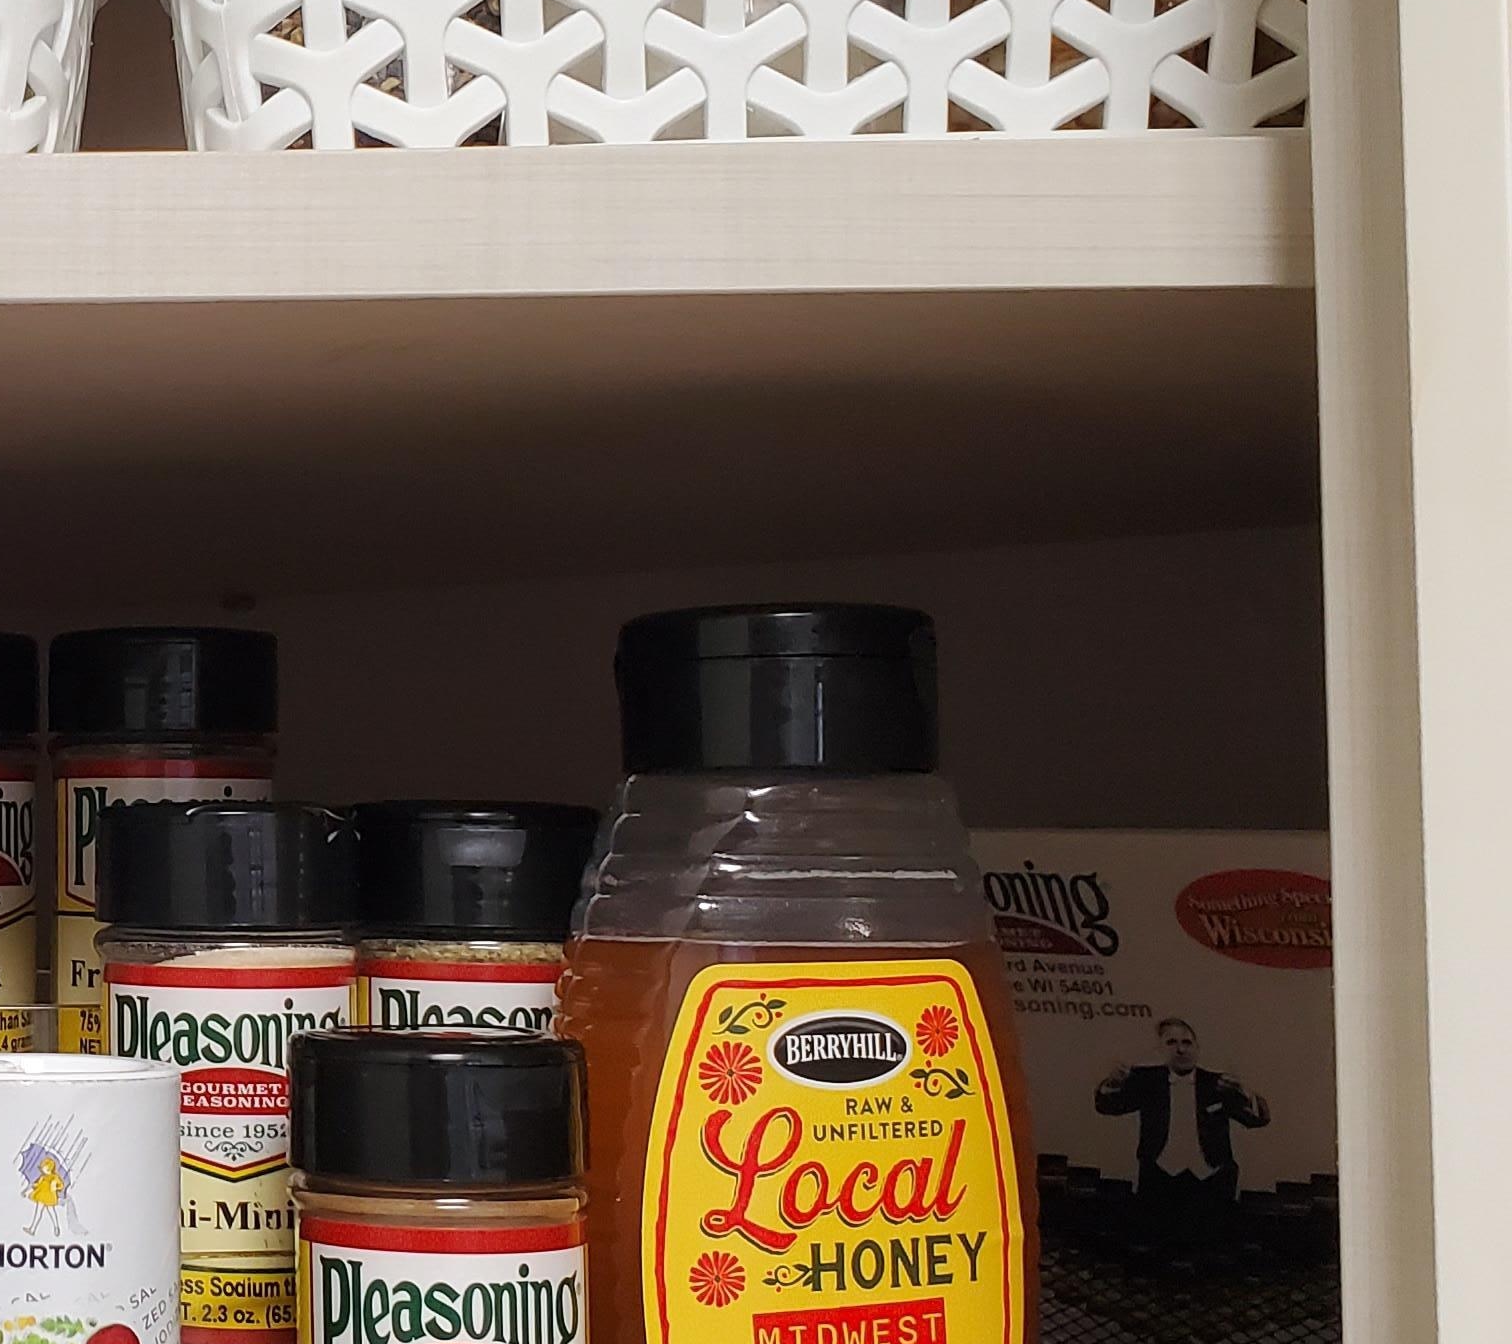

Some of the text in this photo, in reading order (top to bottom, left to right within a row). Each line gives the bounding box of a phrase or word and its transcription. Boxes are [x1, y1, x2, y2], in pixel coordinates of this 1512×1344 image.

[1033, 959, 1105, 977] Avenue
[784, 1032, 898, 1066] BERRYHILL
[180, 1082, 284, 1097] GOURMET
[846, 1096, 914, 1115] RAW &
[813, 1119, 944, 1142] UNFILTERED
[700, 1106, 968, 1254] Local
[809, 1231, 988, 1293] HONEY
[209, 1276, 280, 1297] Sodium
[202, 1303, 261, 1325] 2.3 oz.
